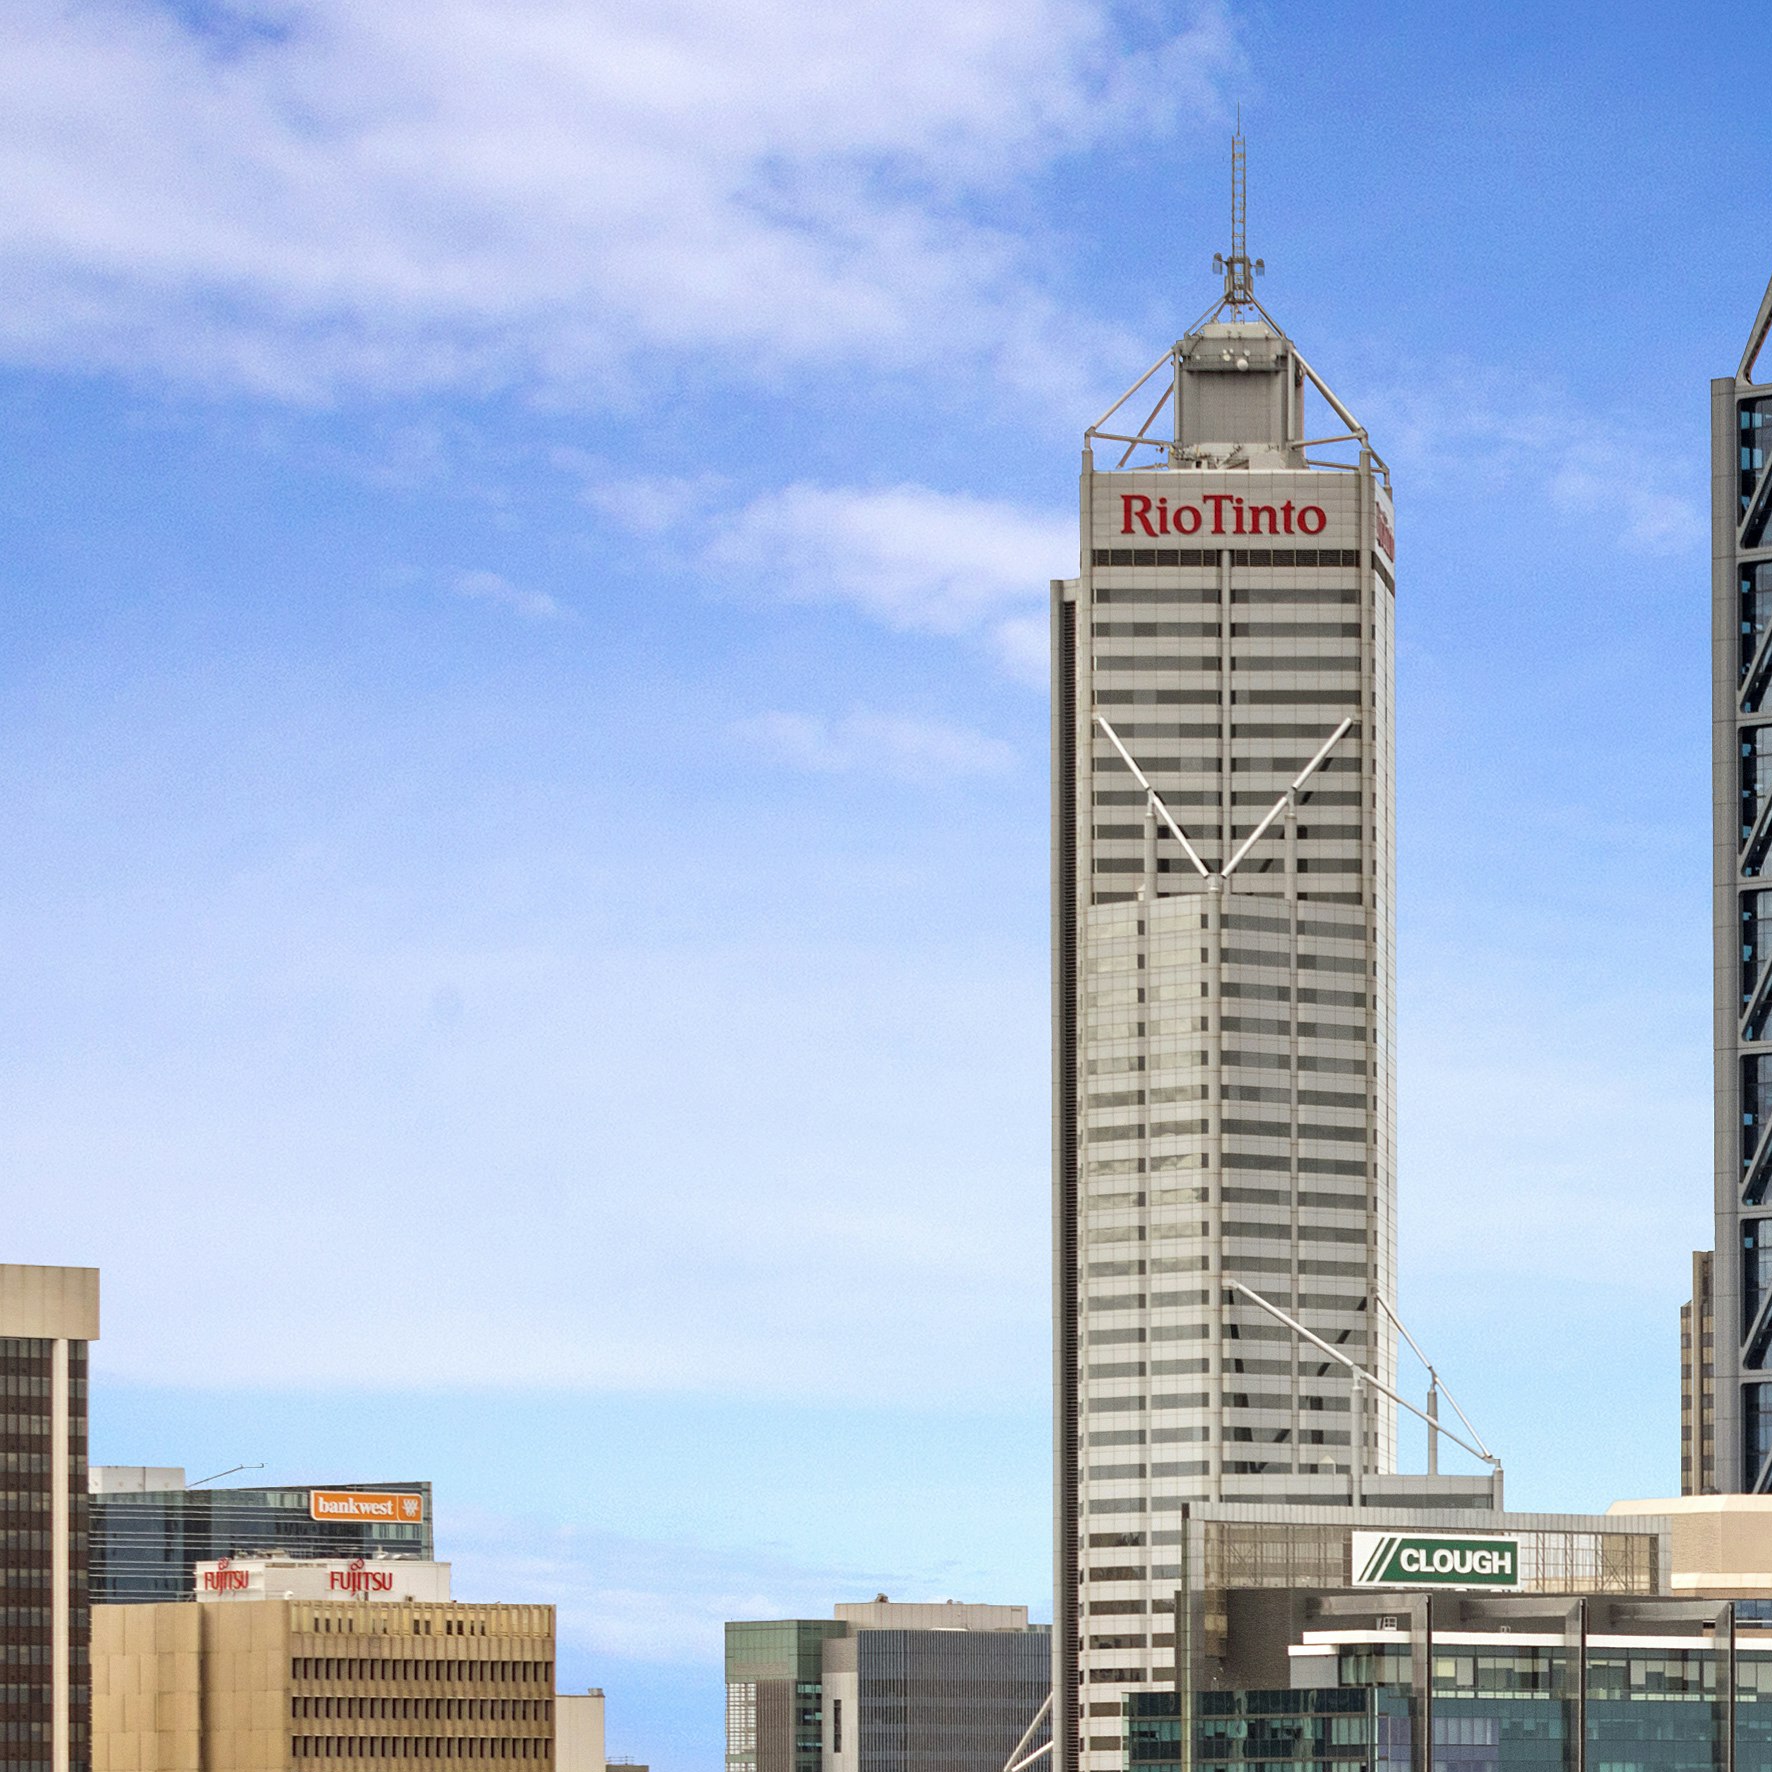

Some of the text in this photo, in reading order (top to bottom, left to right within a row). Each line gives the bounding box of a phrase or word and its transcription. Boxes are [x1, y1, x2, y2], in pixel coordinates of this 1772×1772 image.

[318, 1496, 394, 1516] bankwest
[1400, 1548, 1512, 1574] CLOUGH
[204, 1570, 249, 1596] FUJITSU
[330, 1571, 393, 1596] FUJITSU
